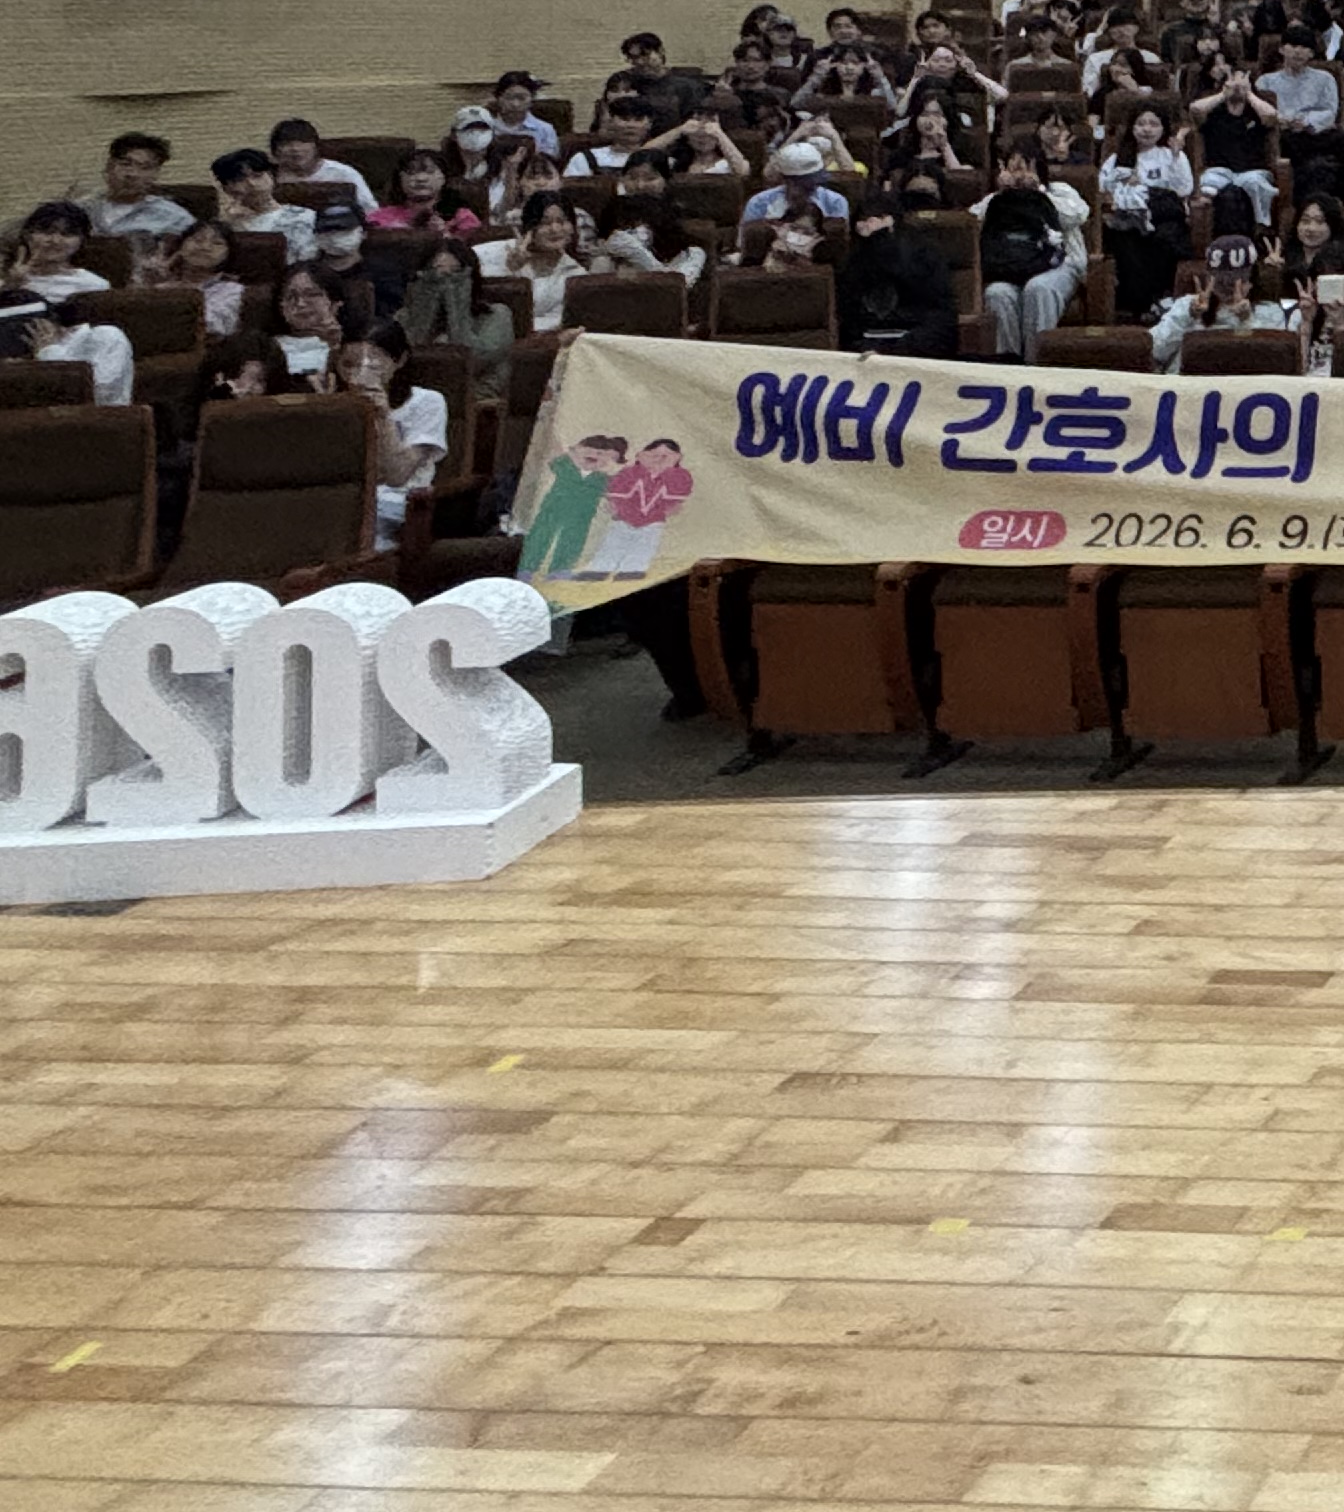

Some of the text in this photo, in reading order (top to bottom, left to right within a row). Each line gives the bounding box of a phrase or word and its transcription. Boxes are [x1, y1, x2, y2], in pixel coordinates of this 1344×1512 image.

[734, 372, 922, 470] 예비
[939, 384, 1321, 484] 간호사의
[979, 514, 1048, 548] 일시
[1083, 512, 1207, 549] 2026.
[1226, 513, 1262, 549] 6.
